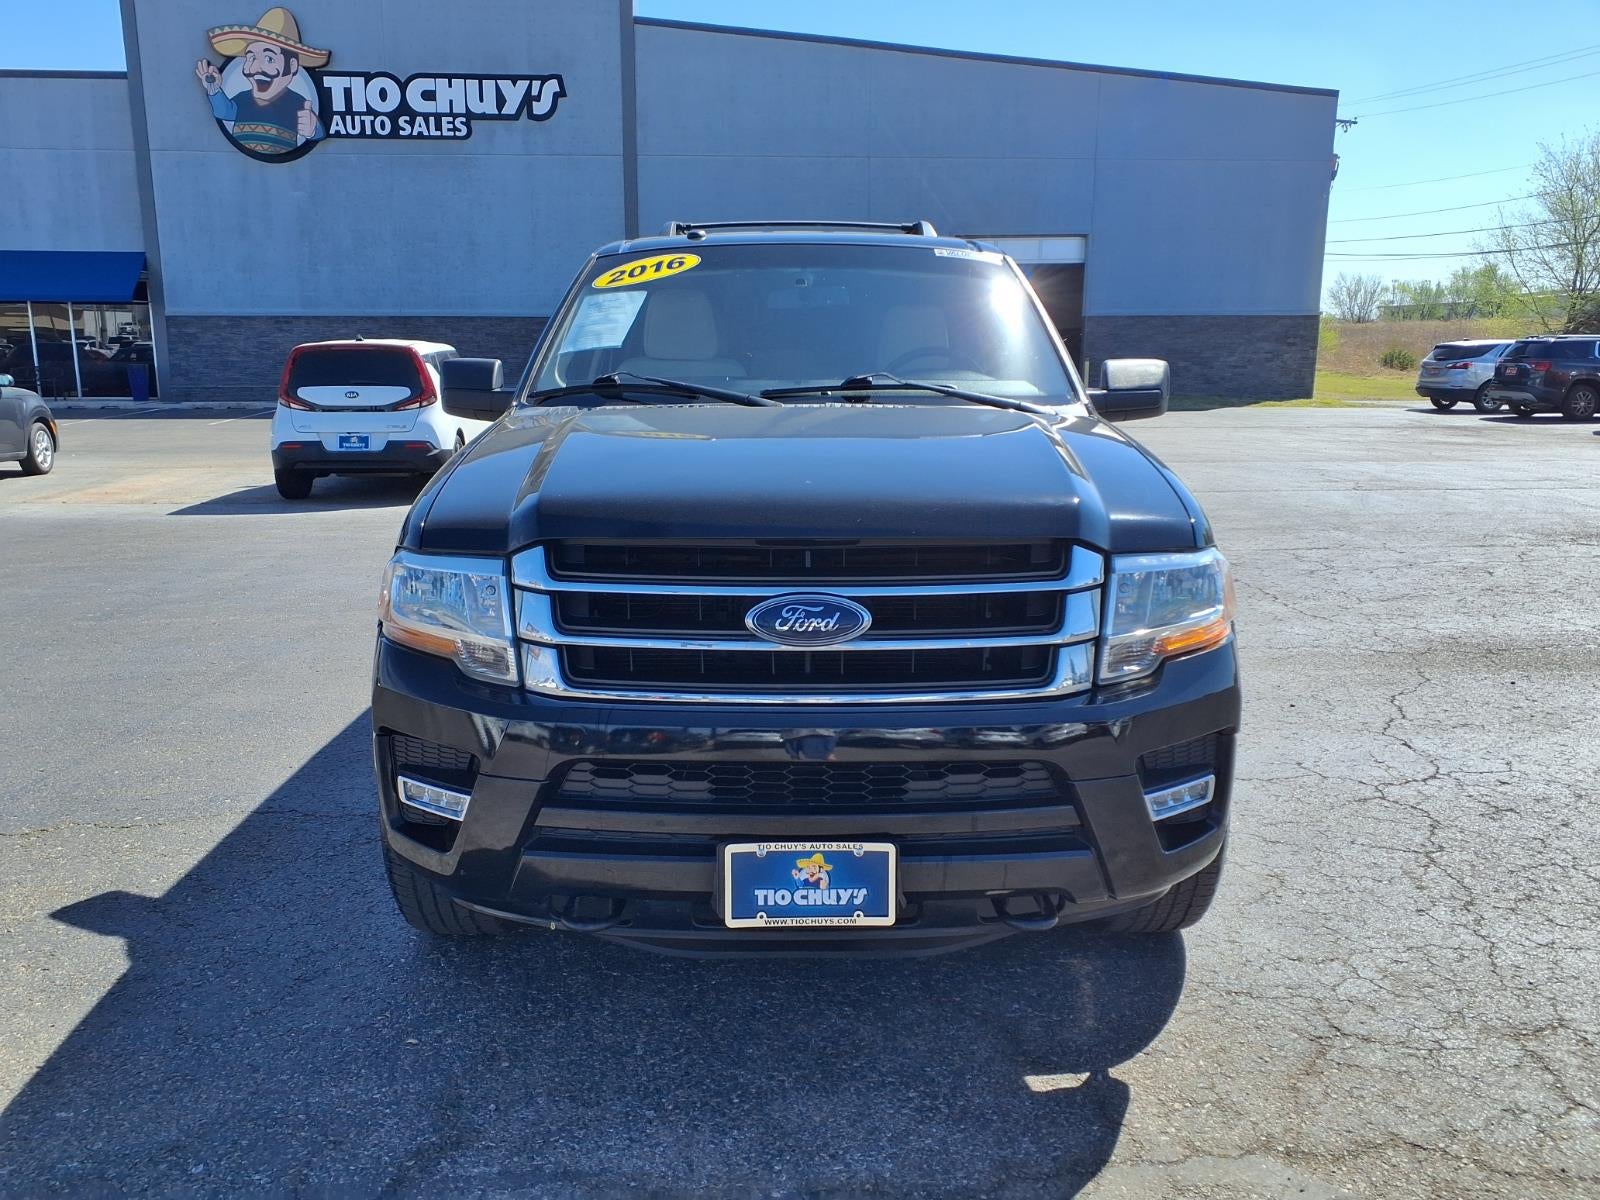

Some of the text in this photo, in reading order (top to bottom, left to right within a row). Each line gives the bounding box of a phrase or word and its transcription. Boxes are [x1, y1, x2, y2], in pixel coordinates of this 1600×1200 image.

[323, 76, 561, 116] TIO CHUY'S
[329, 115, 468, 137] AUTO SALES
[606, 256, 687, 285] 2016
[775, 605, 840, 632] Ford
[754, 888, 867, 906] TIO CHUY'S
